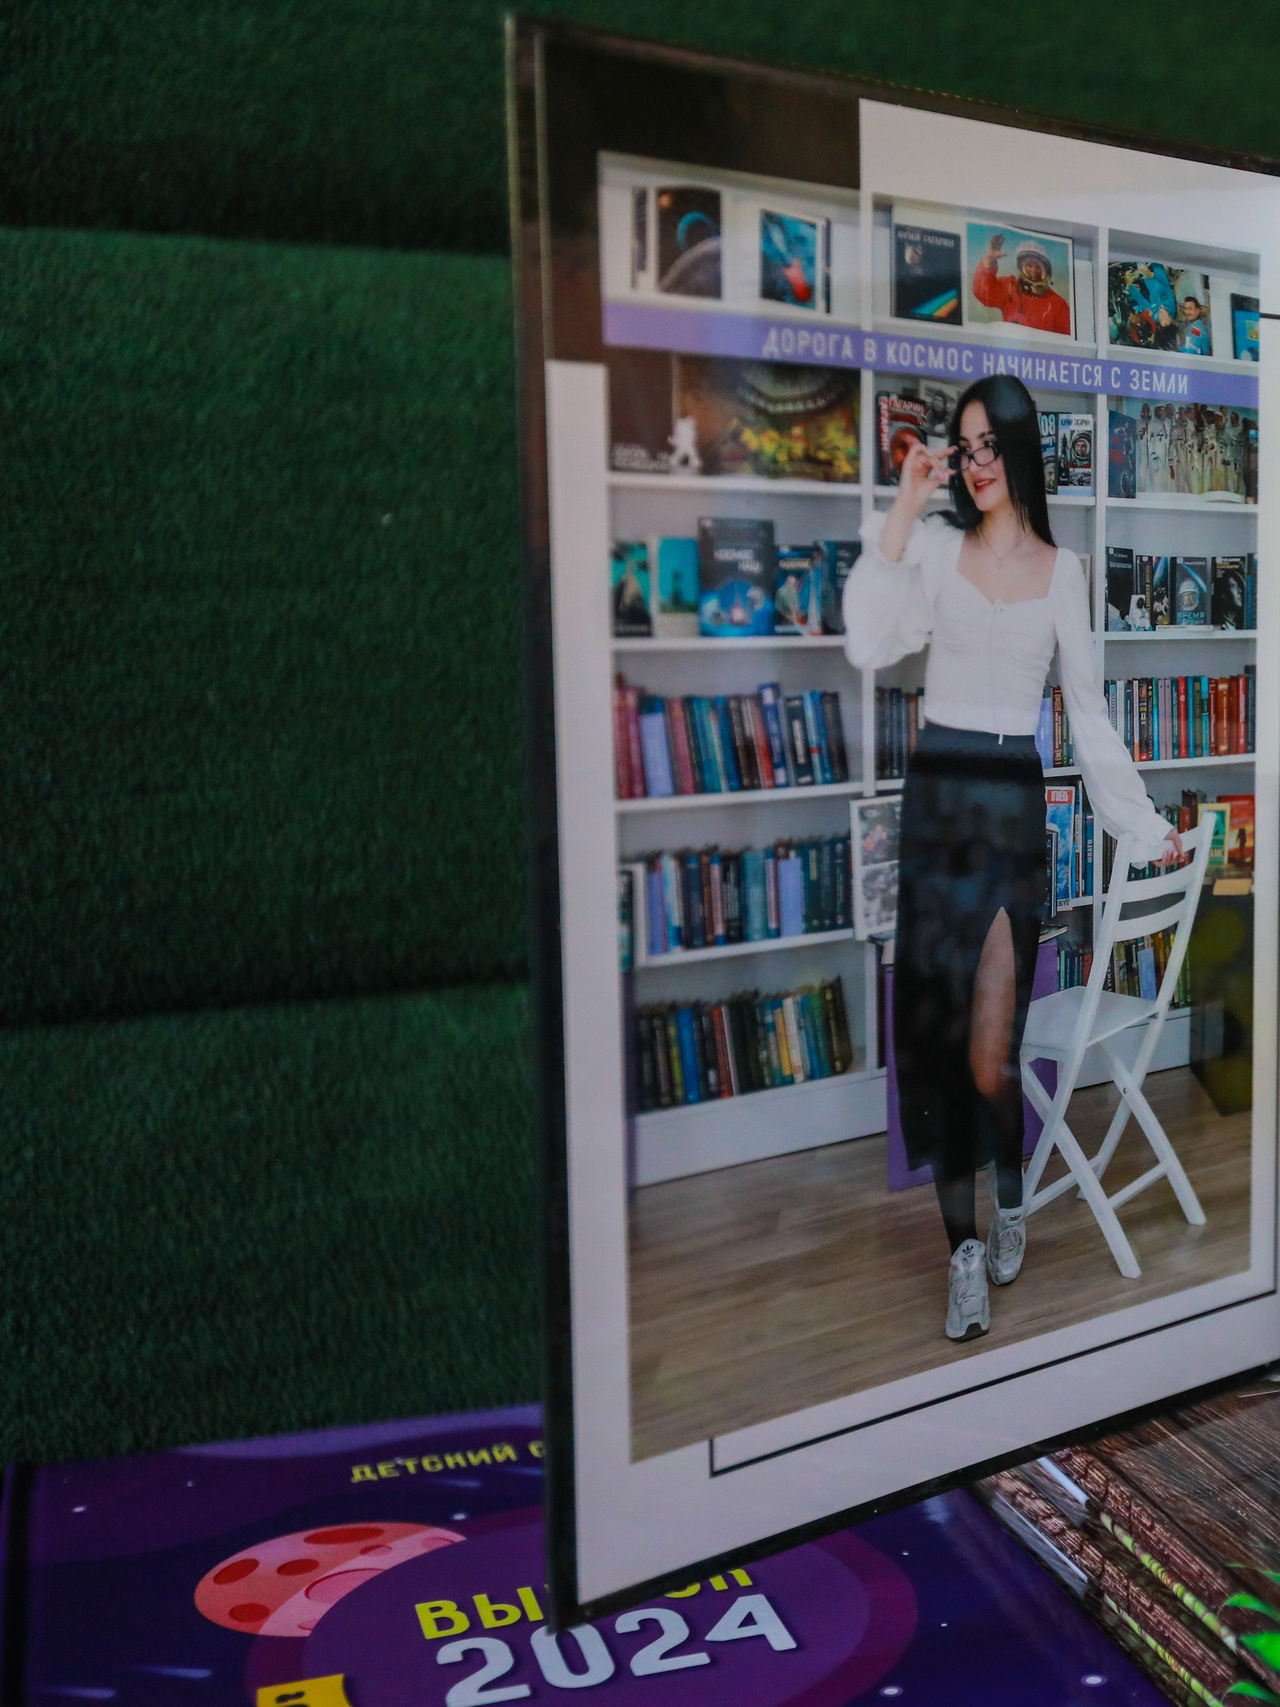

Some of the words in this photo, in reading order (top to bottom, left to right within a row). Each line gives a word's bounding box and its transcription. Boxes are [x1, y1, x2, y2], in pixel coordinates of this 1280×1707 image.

[762, 326, 855, 361] ДОРОГА
[863, 337, 878, 363] В
[885, 340, 974, 373] КОСМОС
[982, 351, 1103, 387] НАЧИНАЕТСЯ
[1110, 366, 1122, 389] С
[1129, 368, 1189, 396] ЗЕМЛИ
[436, 1594, 798, 1707] 2024
